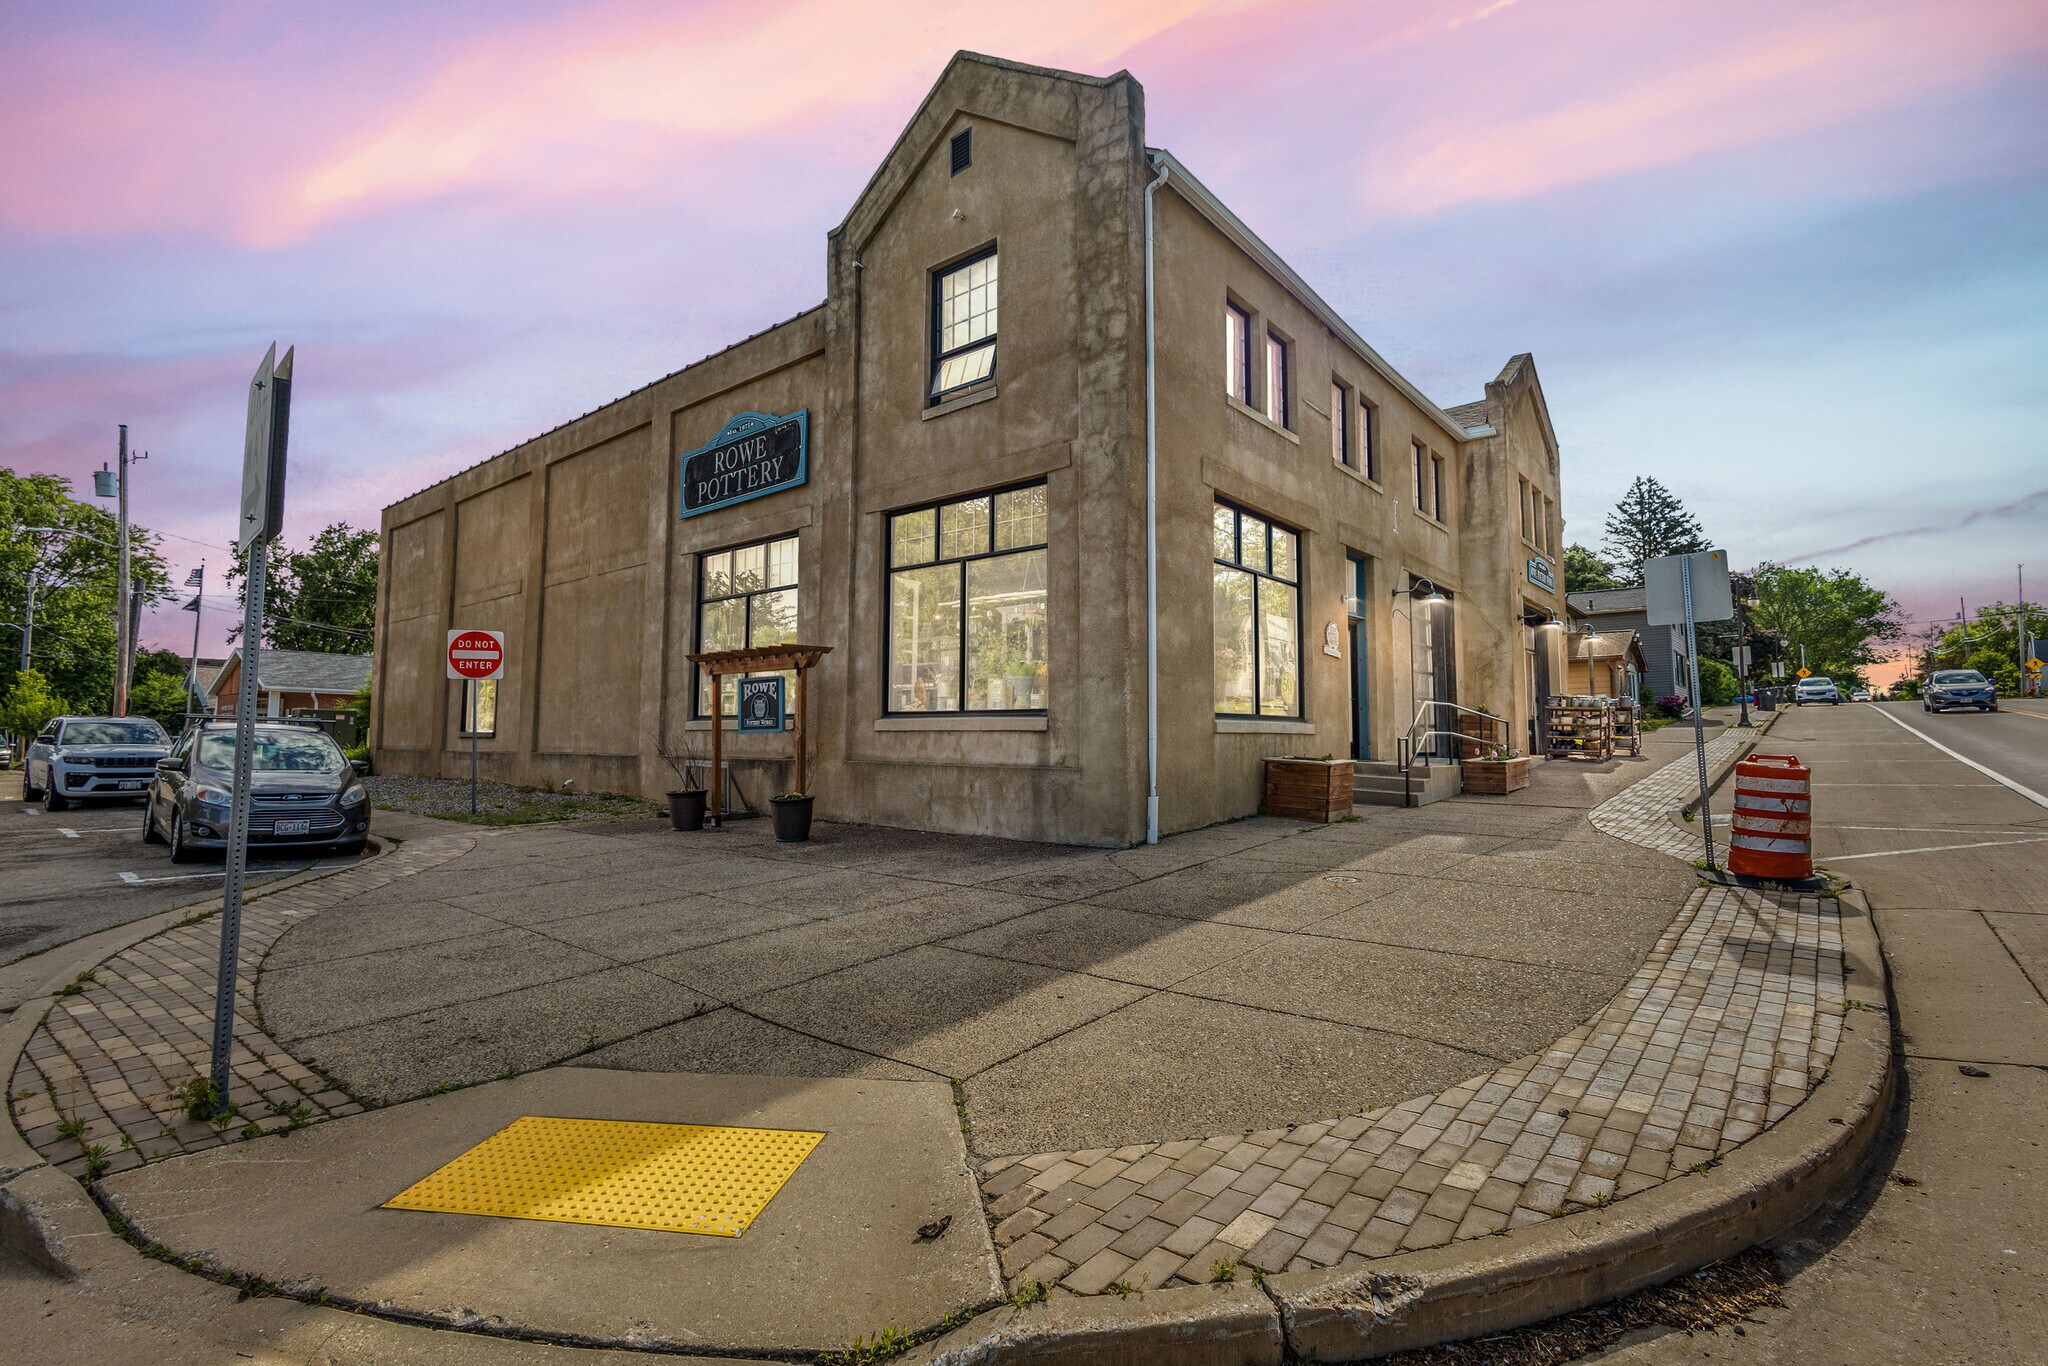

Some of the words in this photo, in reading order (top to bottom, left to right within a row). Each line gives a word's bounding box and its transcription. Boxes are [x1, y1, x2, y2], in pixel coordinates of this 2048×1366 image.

[714, 435, 767, 474] ROWE
[697, 455, 784, 504] POTTERY
[458, 640, 472, 648] DO
[474, 640, 495, 649] NOT
[459, 661, 493, 669] ENTER
[743, 681, 777, 702] ROWE
